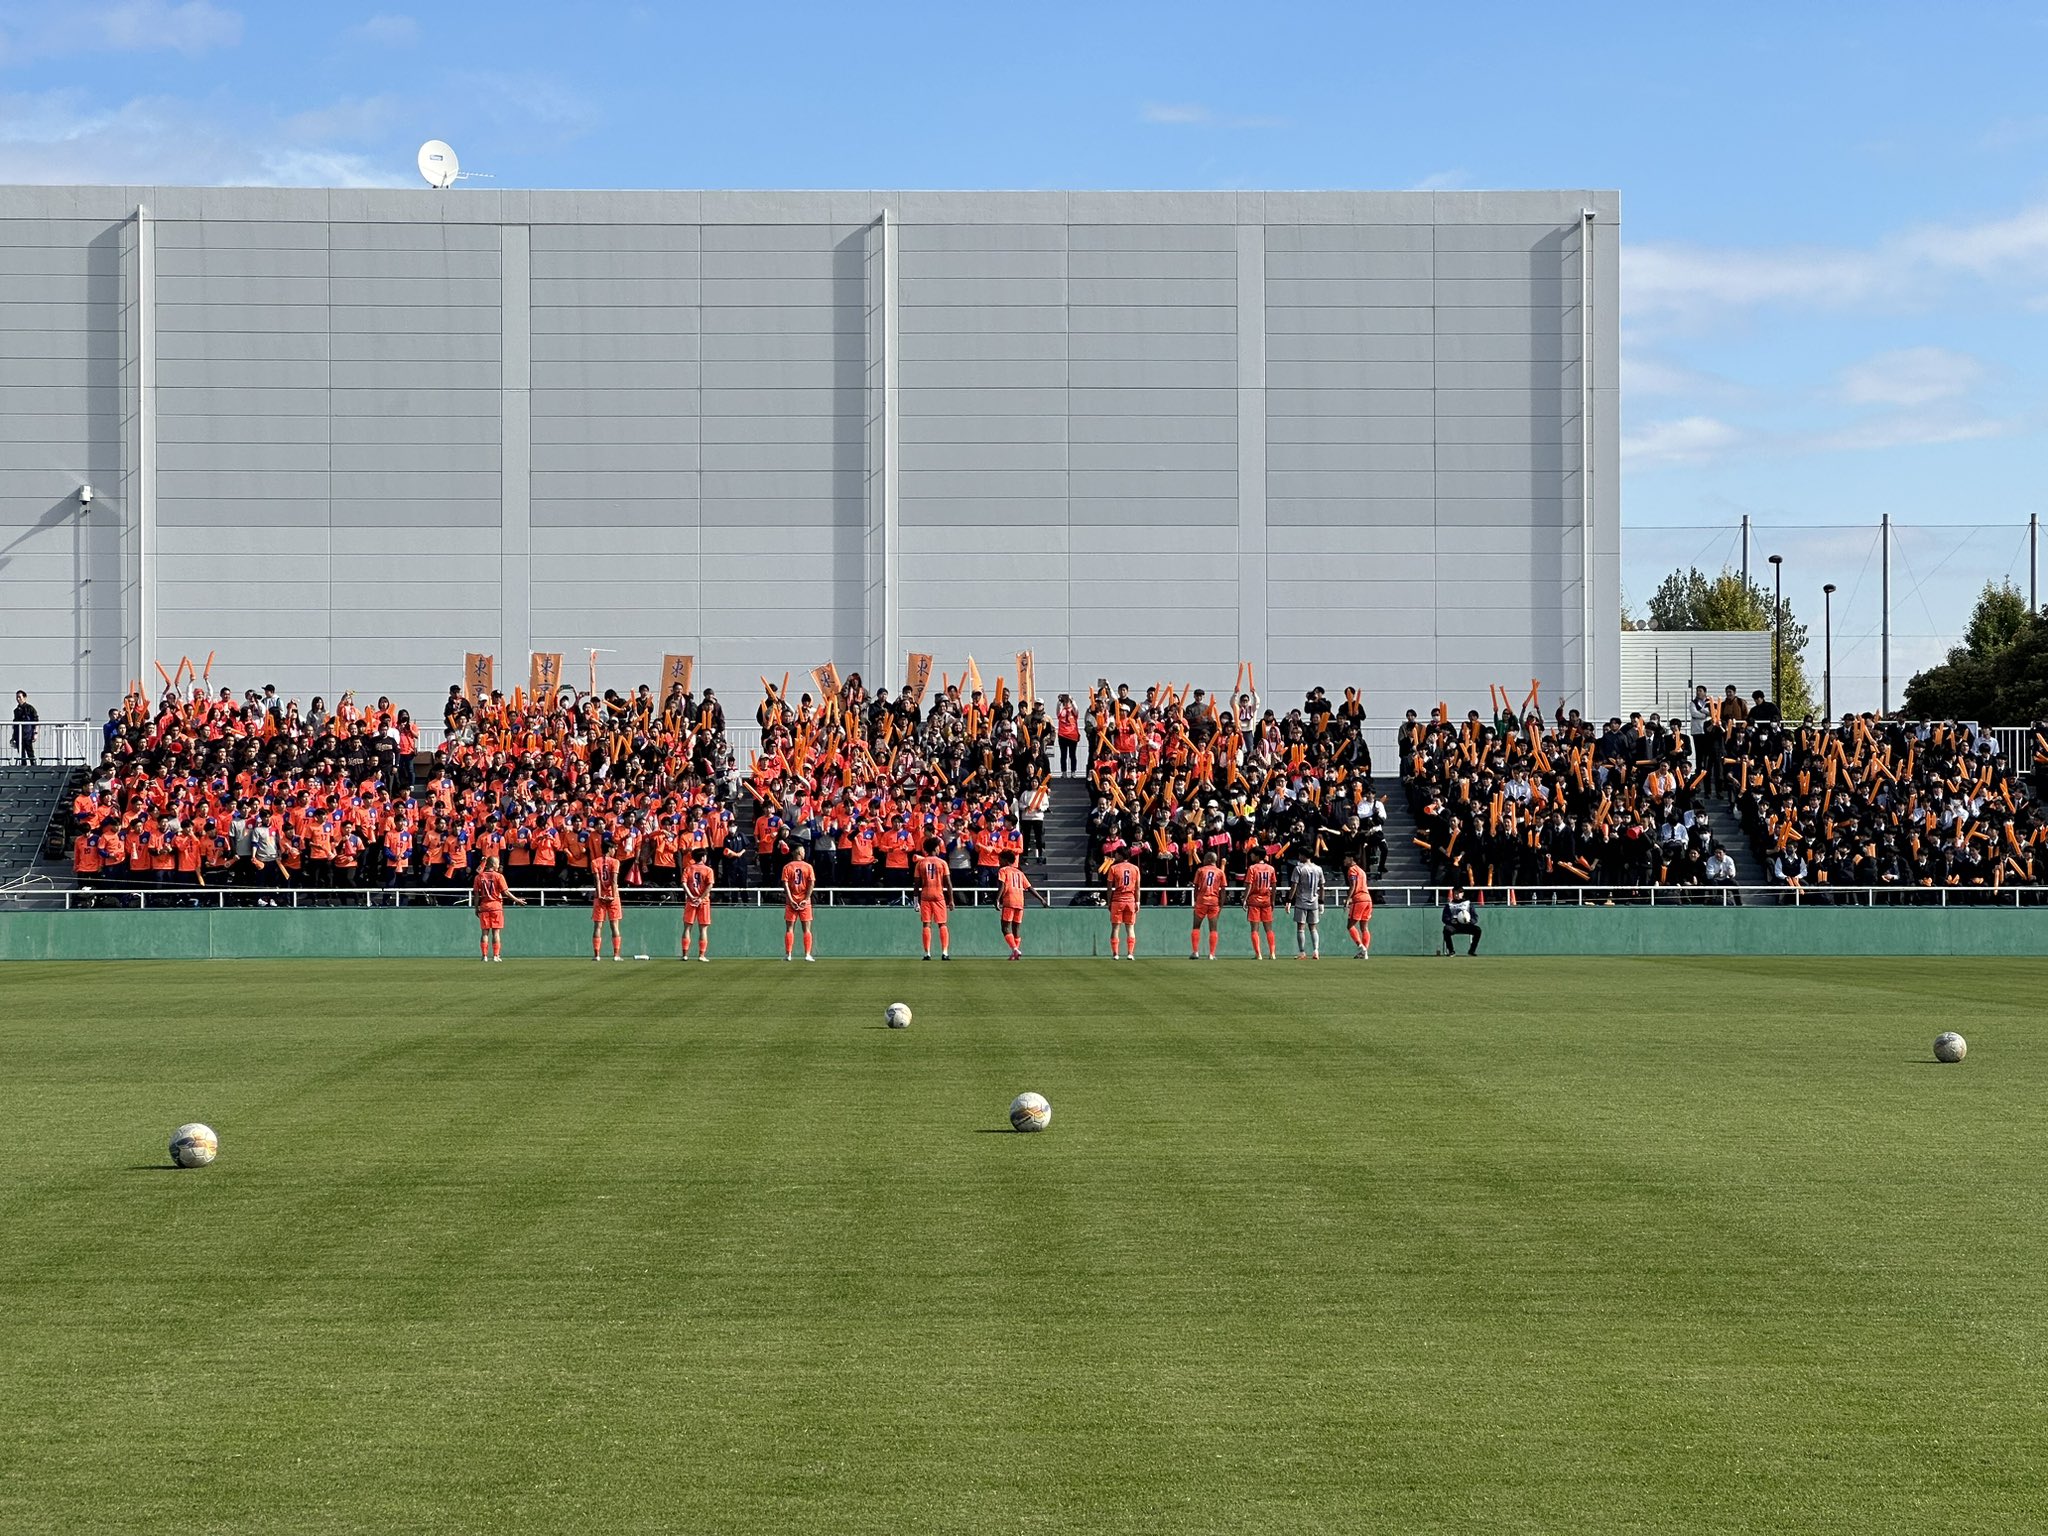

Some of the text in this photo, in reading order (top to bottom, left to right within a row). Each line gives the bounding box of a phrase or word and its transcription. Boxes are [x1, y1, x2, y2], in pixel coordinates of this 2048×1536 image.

[794, 868, 803, 885] 3
[927, 863, 936, 880] 4
[1123, 869, 1131, 886] 6
[1206, 871, 1215, 887] 8
[1257, 871, 1270, 889] 14
